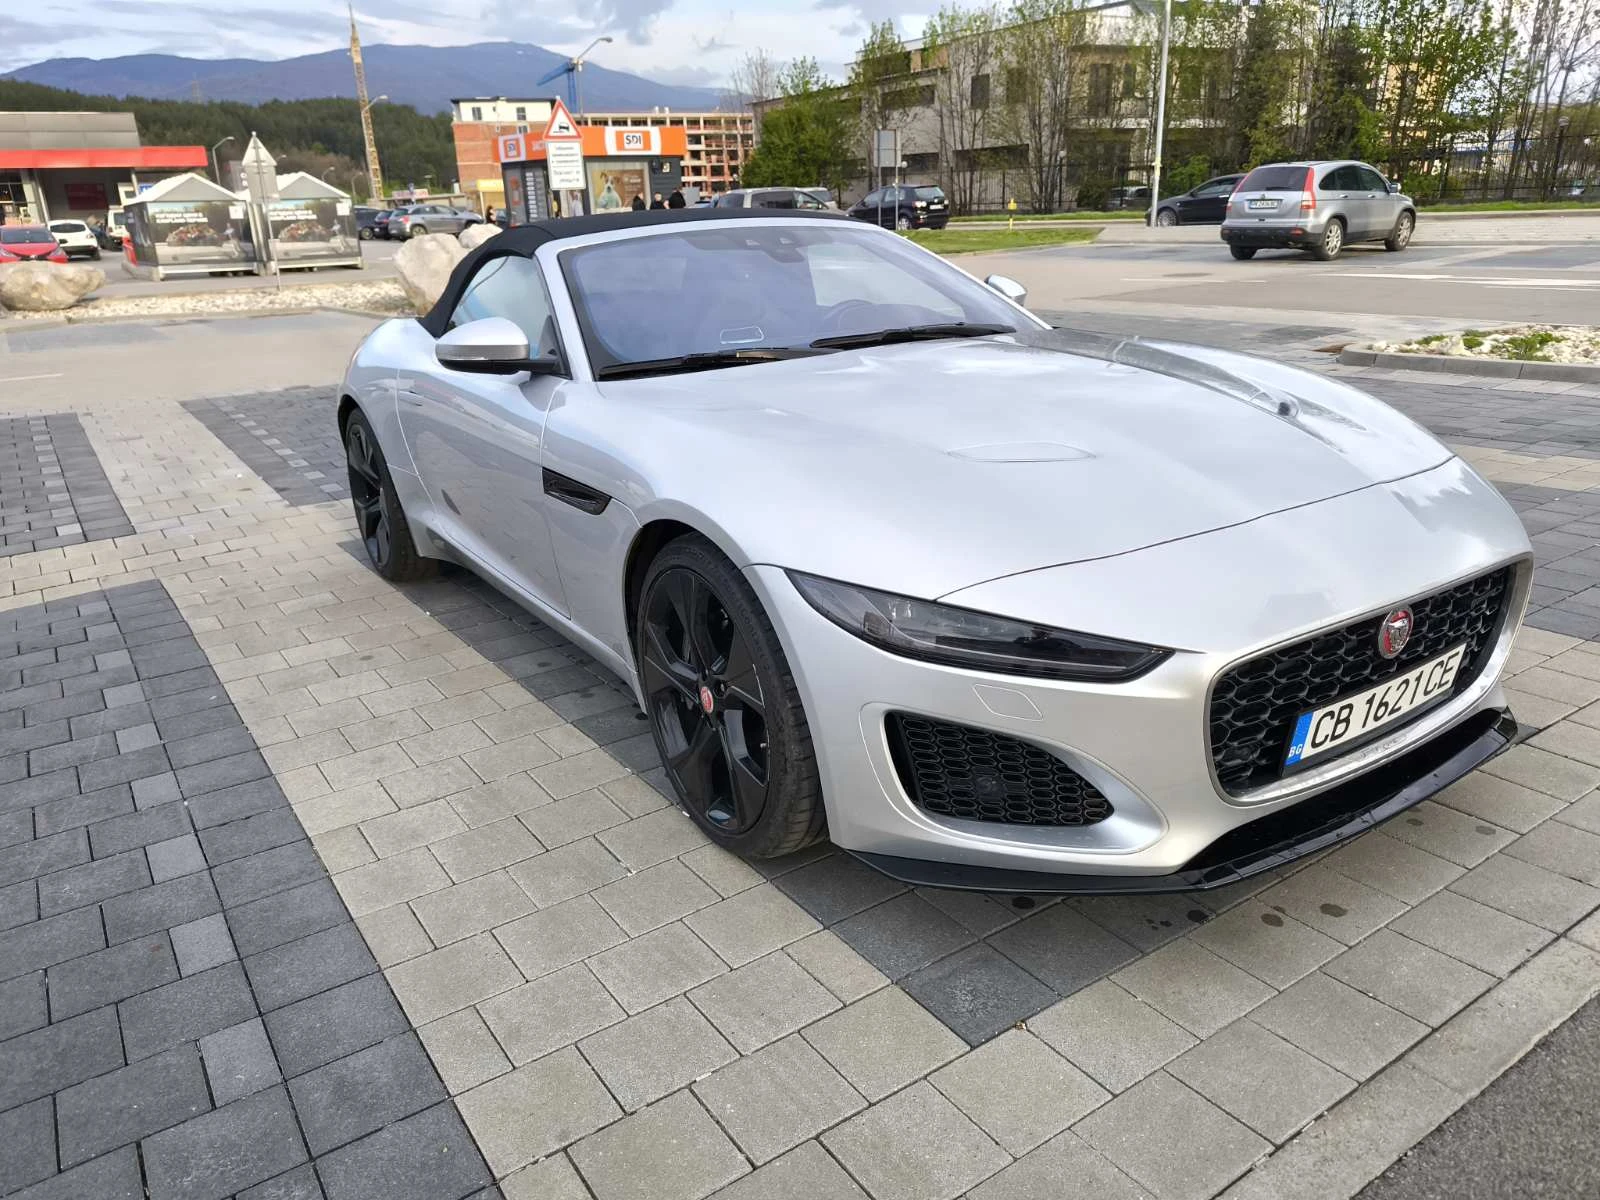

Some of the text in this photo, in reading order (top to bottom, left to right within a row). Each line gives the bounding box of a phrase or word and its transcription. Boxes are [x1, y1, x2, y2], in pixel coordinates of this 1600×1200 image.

[625, 134, 642, 145] SDI
[1311, 703, 1354, 749] CB
[1362, 670, 1424, 728] 1621
[1289, 743, 1303, 757] BG
